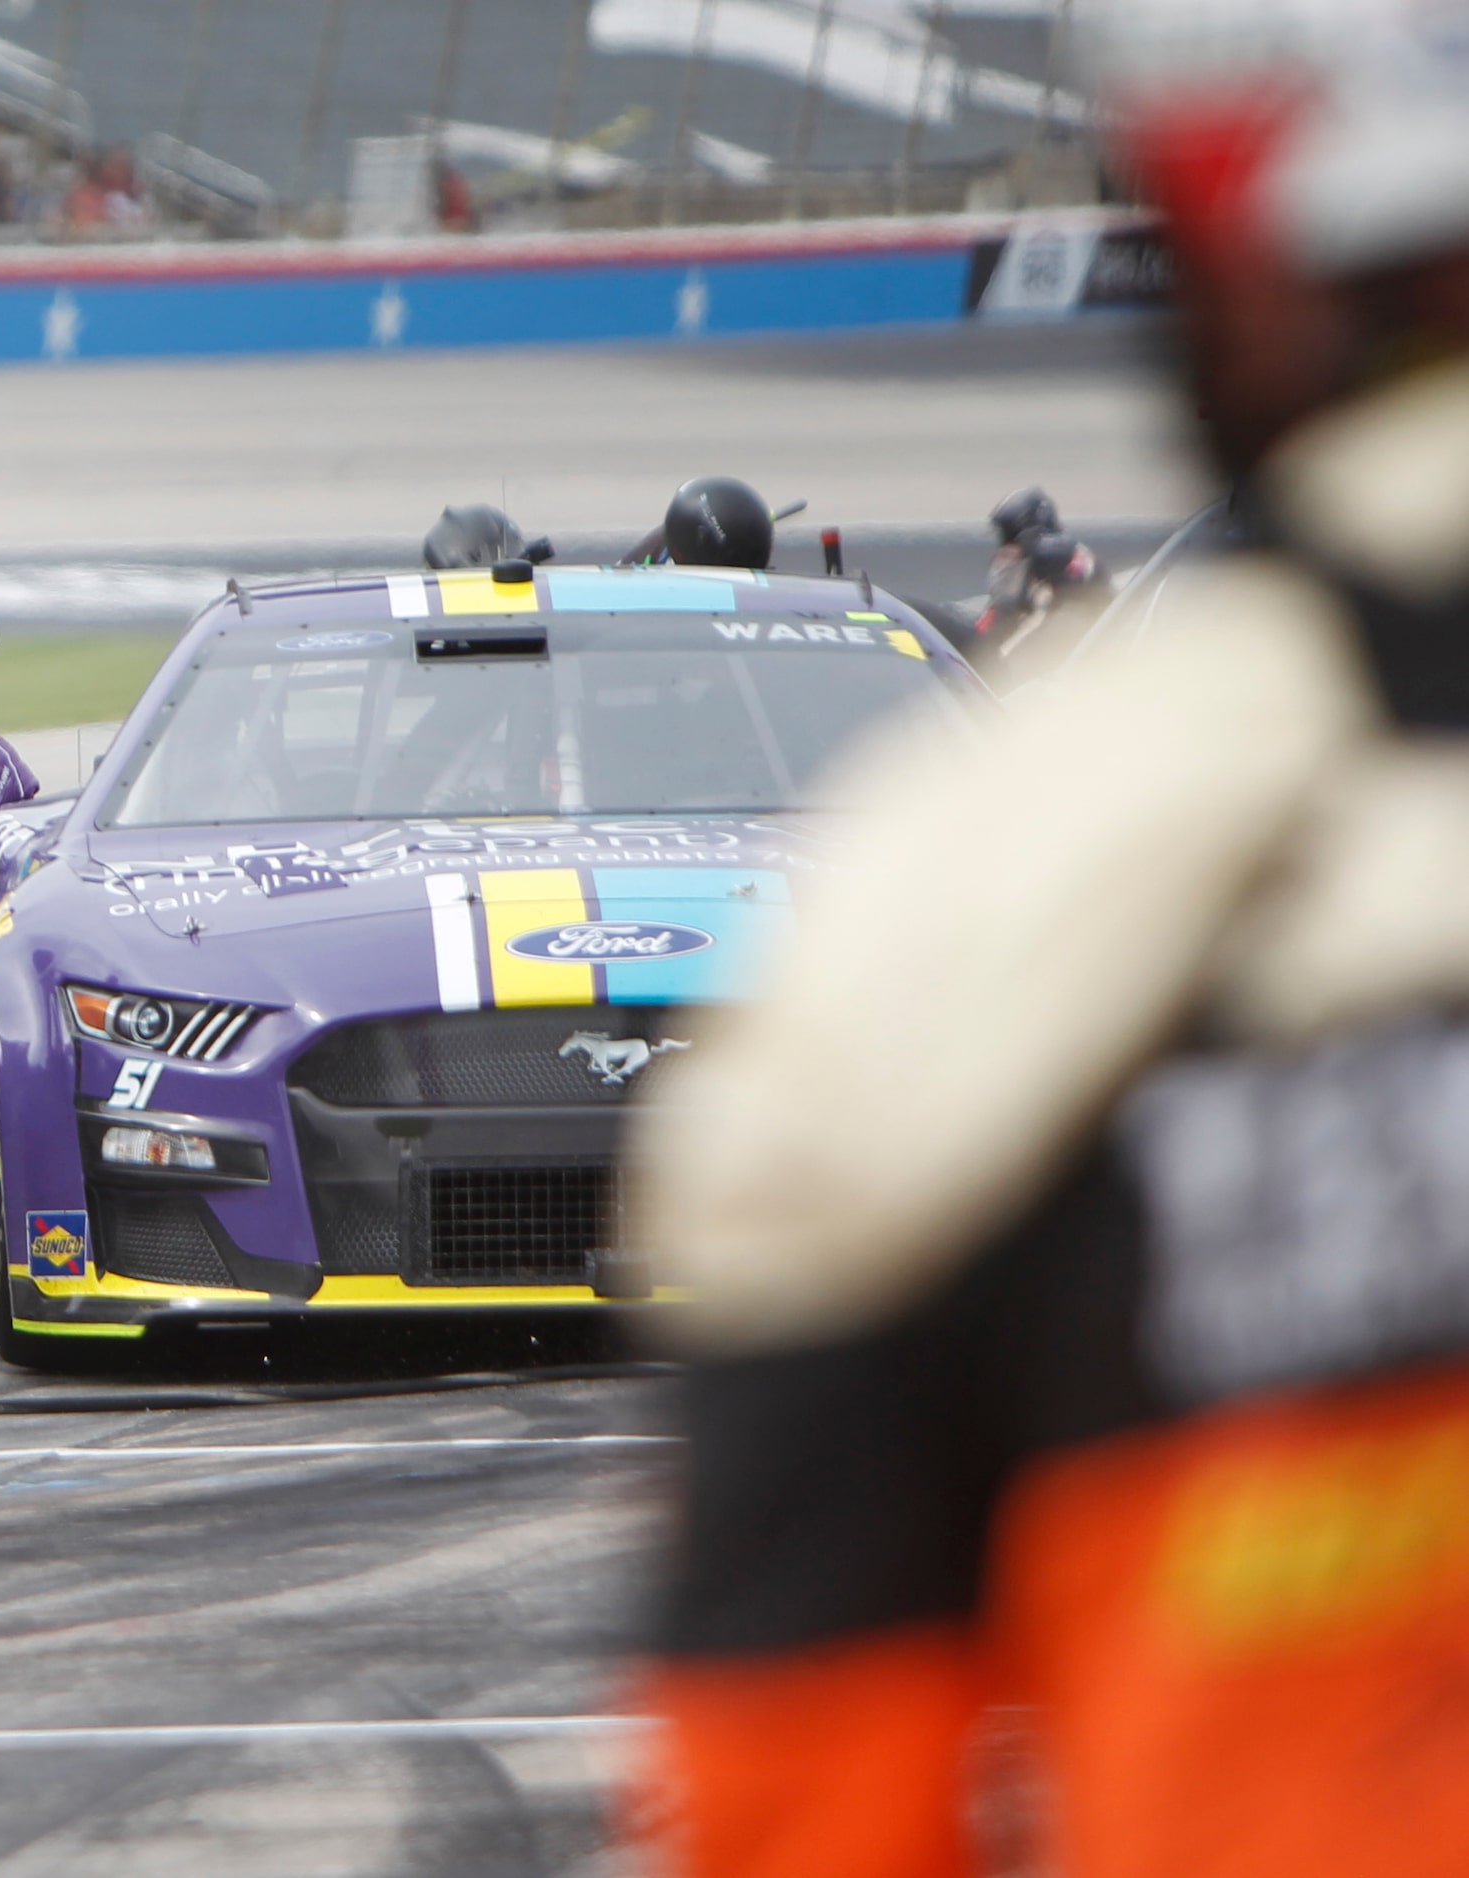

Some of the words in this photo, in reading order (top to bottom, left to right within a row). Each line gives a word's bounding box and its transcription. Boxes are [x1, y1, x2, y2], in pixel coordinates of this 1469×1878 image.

[712, 621, 876, 645] WARE
[109, 887, 228, 917] orally
[577, 848, 740, 863] tablets
[547, 925, 673, 956] Ford
[107, 1058, 166, 1110] 51
[32, 1235, 85, 1257] SUNOCO
